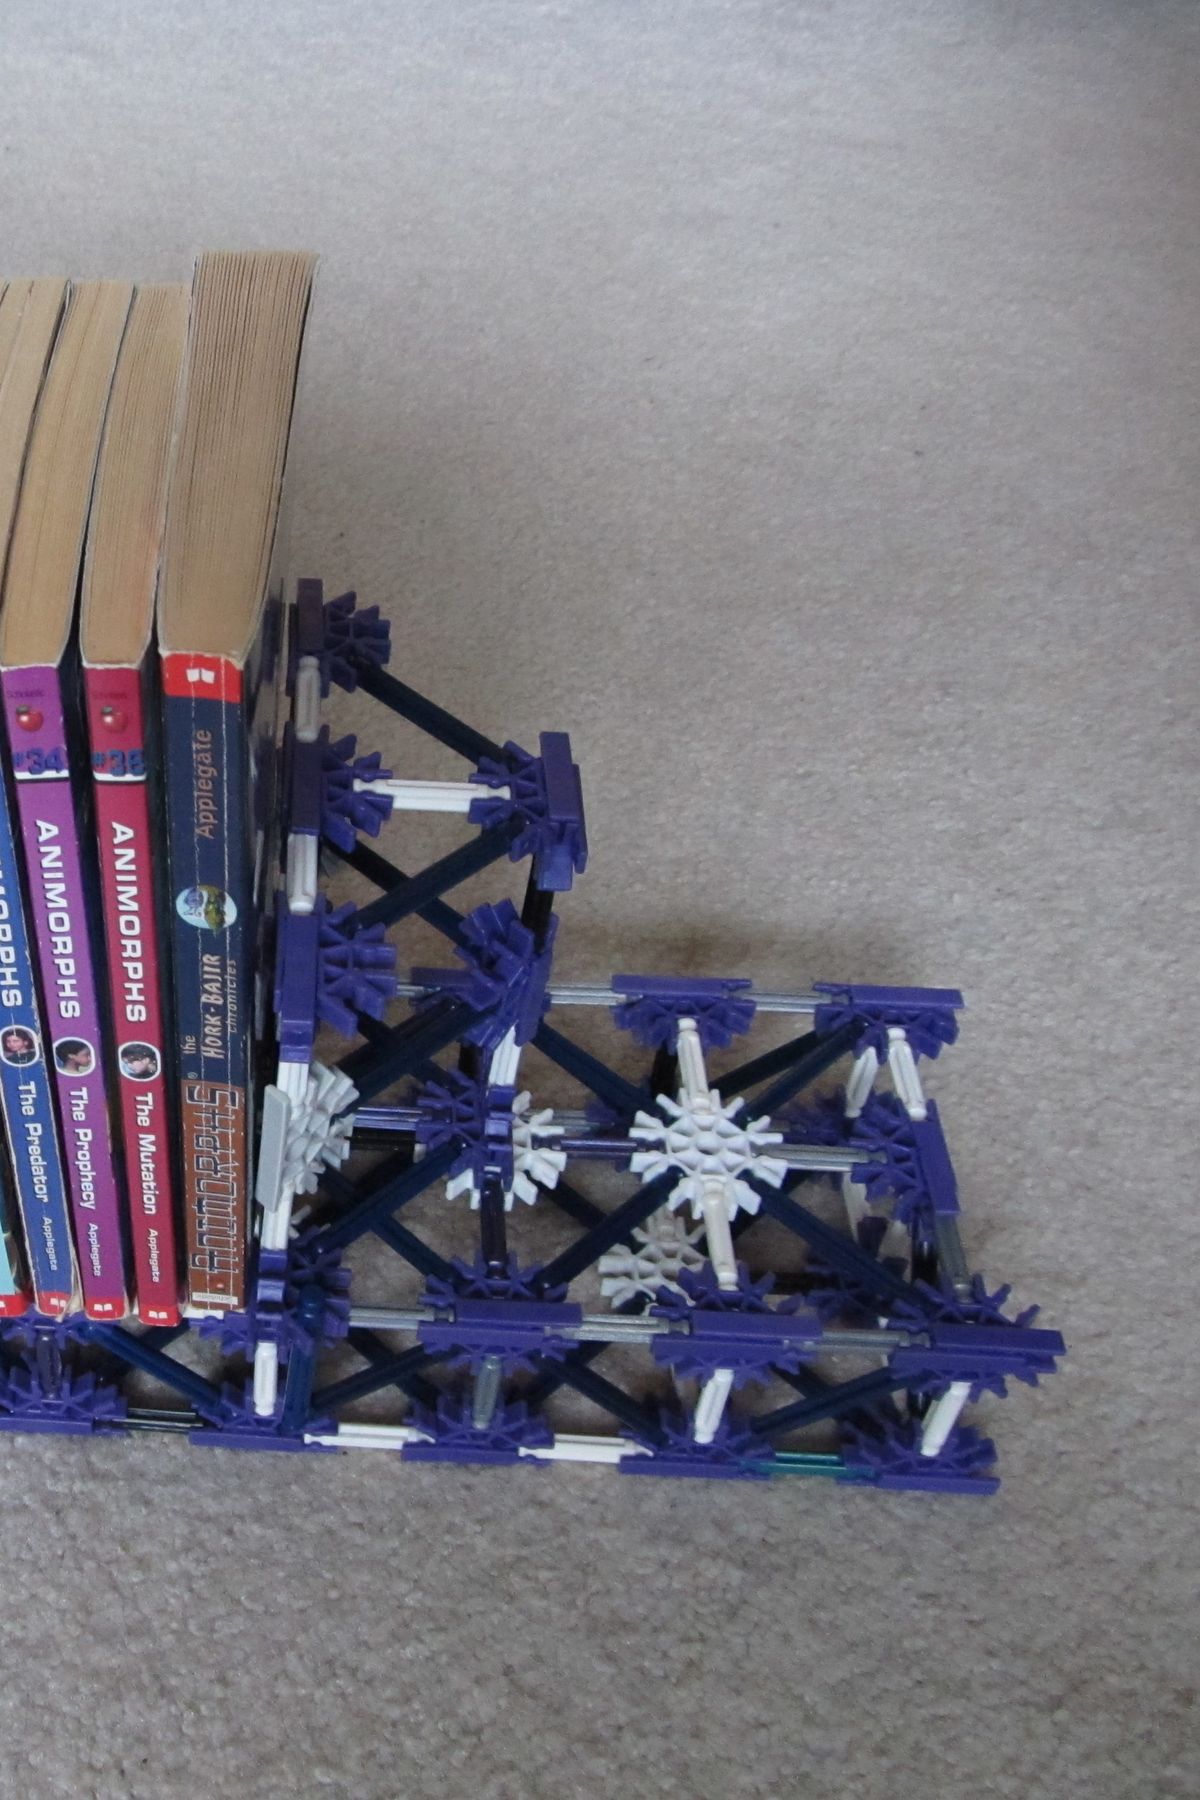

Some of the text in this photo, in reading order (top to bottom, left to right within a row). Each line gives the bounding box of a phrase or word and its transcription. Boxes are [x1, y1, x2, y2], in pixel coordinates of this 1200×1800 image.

[12, 747, 65, 775] #34
[194, 729, 216, 840] Applegate
[36, 819, 81, 1019] ANIMORPHS
[111, 821, 147, 1023] ANIMORPHS
[182, 1034, 196, 1055] the
[18, 1081, 49, 1203] The Predator
[69, 1087, 97, 1210] The Prophecy
[134, 1092, 157, 1215] The Mutation
[42, 1217, 58, 1271] Applegate
[88, 1223, 102, 1277] Applegate
[148, 1228, 161, 1283] Applegate
